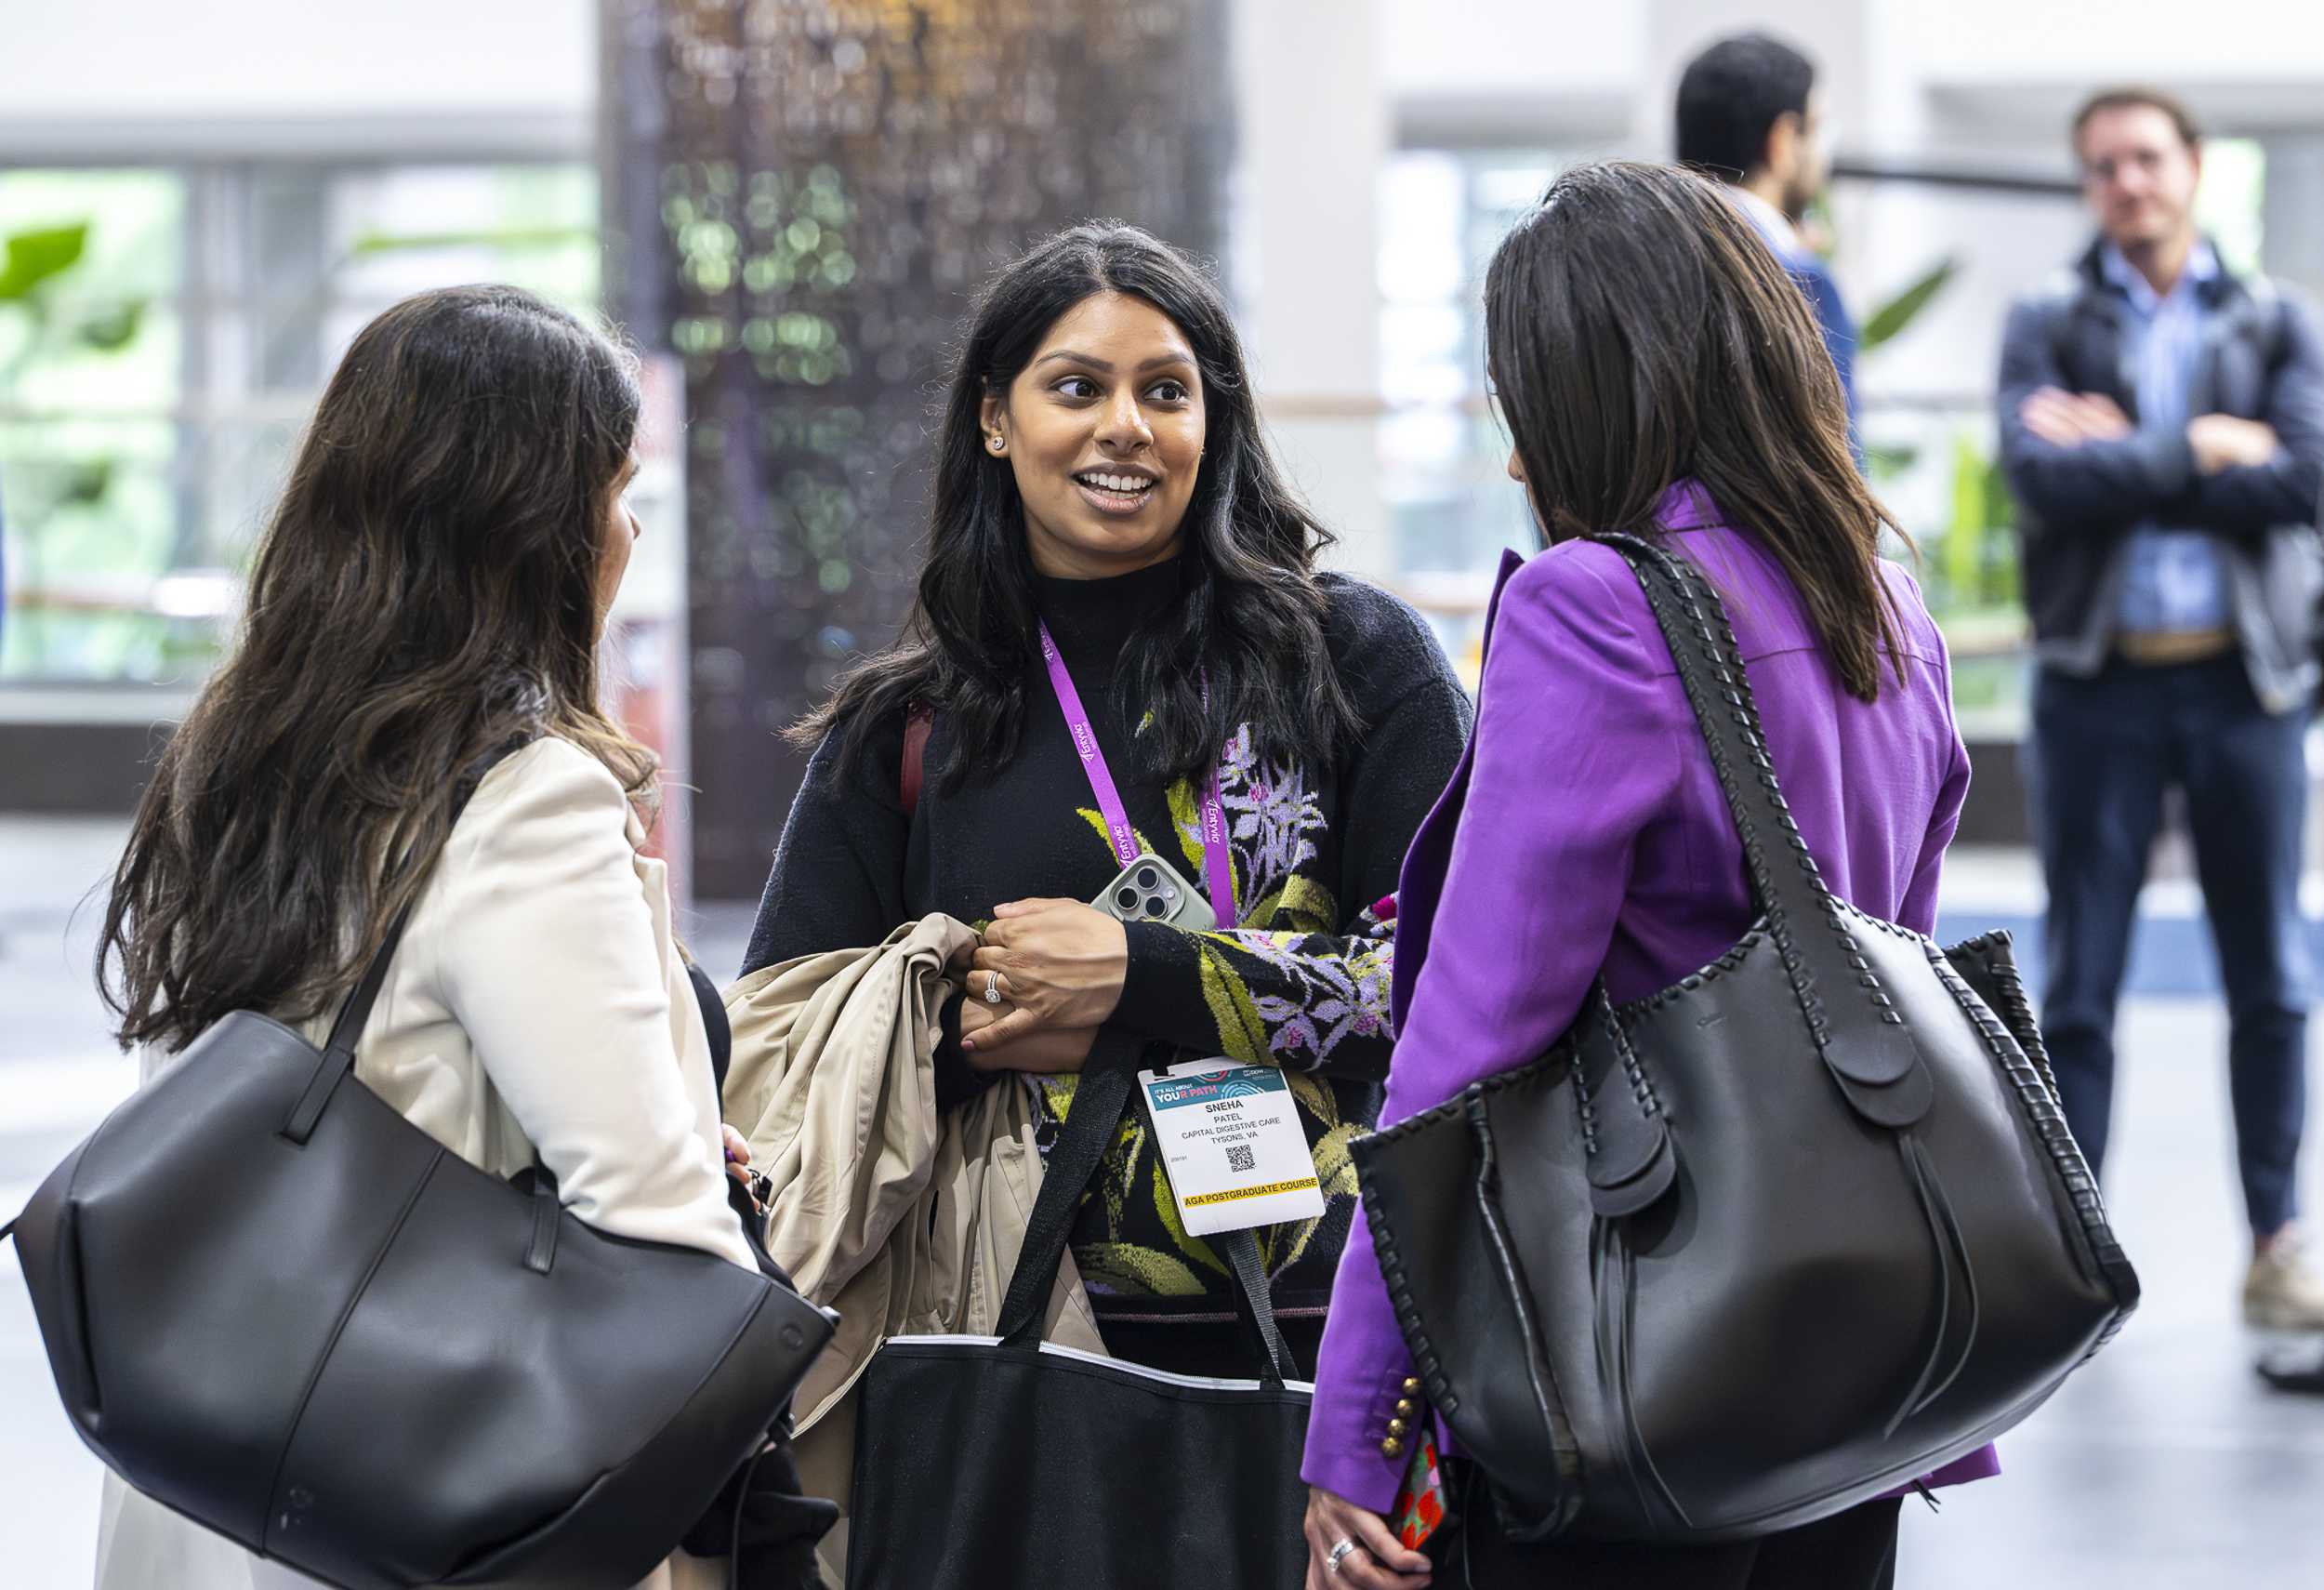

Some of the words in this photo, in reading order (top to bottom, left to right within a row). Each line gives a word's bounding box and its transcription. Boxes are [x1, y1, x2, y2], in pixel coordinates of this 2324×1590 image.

[1208, 808, 1221, 843] Entyvio
[1114, 826, 1131, 860] Entyvio
[1156, 1091, 1187, 1104] YOUR
[1190, 1085, 1218, 1097] PATH
[1205, 1100, 1244, 1113] SNEHA
[1182, 1128, 1214, 1139] CAPITAL
[1216, 1120, 1257, 1133] DIGESTIVE
[1259, 1117, 1281, 1127] CARE
[1213, 1113, 1242, 1123] PATEL
[1246, 1131, 1259, 1139] VA
[1184, 1197, 1205, 1206] AGA
[1206, 1184, 1278, 1202] POSTGRADUATE
[1280, 1178, 1317, 1191] COURSE
